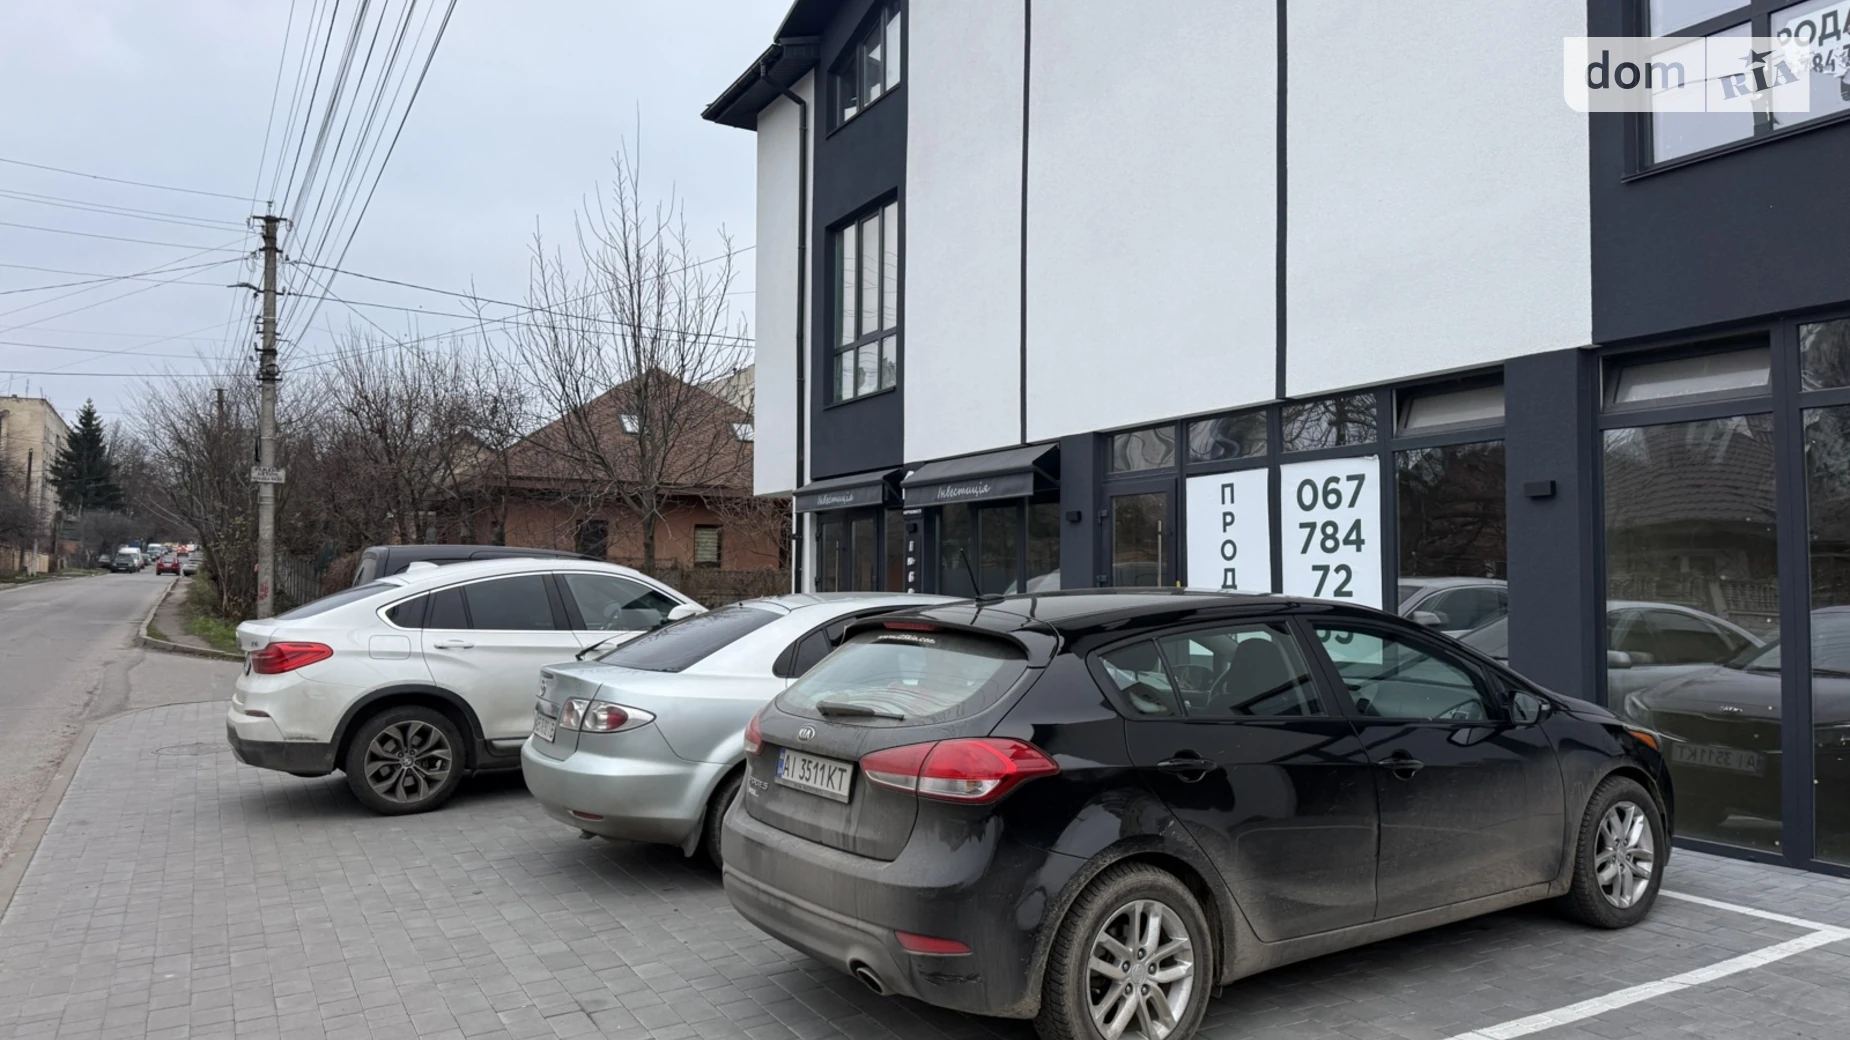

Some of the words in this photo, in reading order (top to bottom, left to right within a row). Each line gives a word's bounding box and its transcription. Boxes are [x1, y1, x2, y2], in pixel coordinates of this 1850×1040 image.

[1296, 473, 1366, 512] 067
[1298, 518, 1366, 555] 784
[1311, 563, 1353, 598] 72
